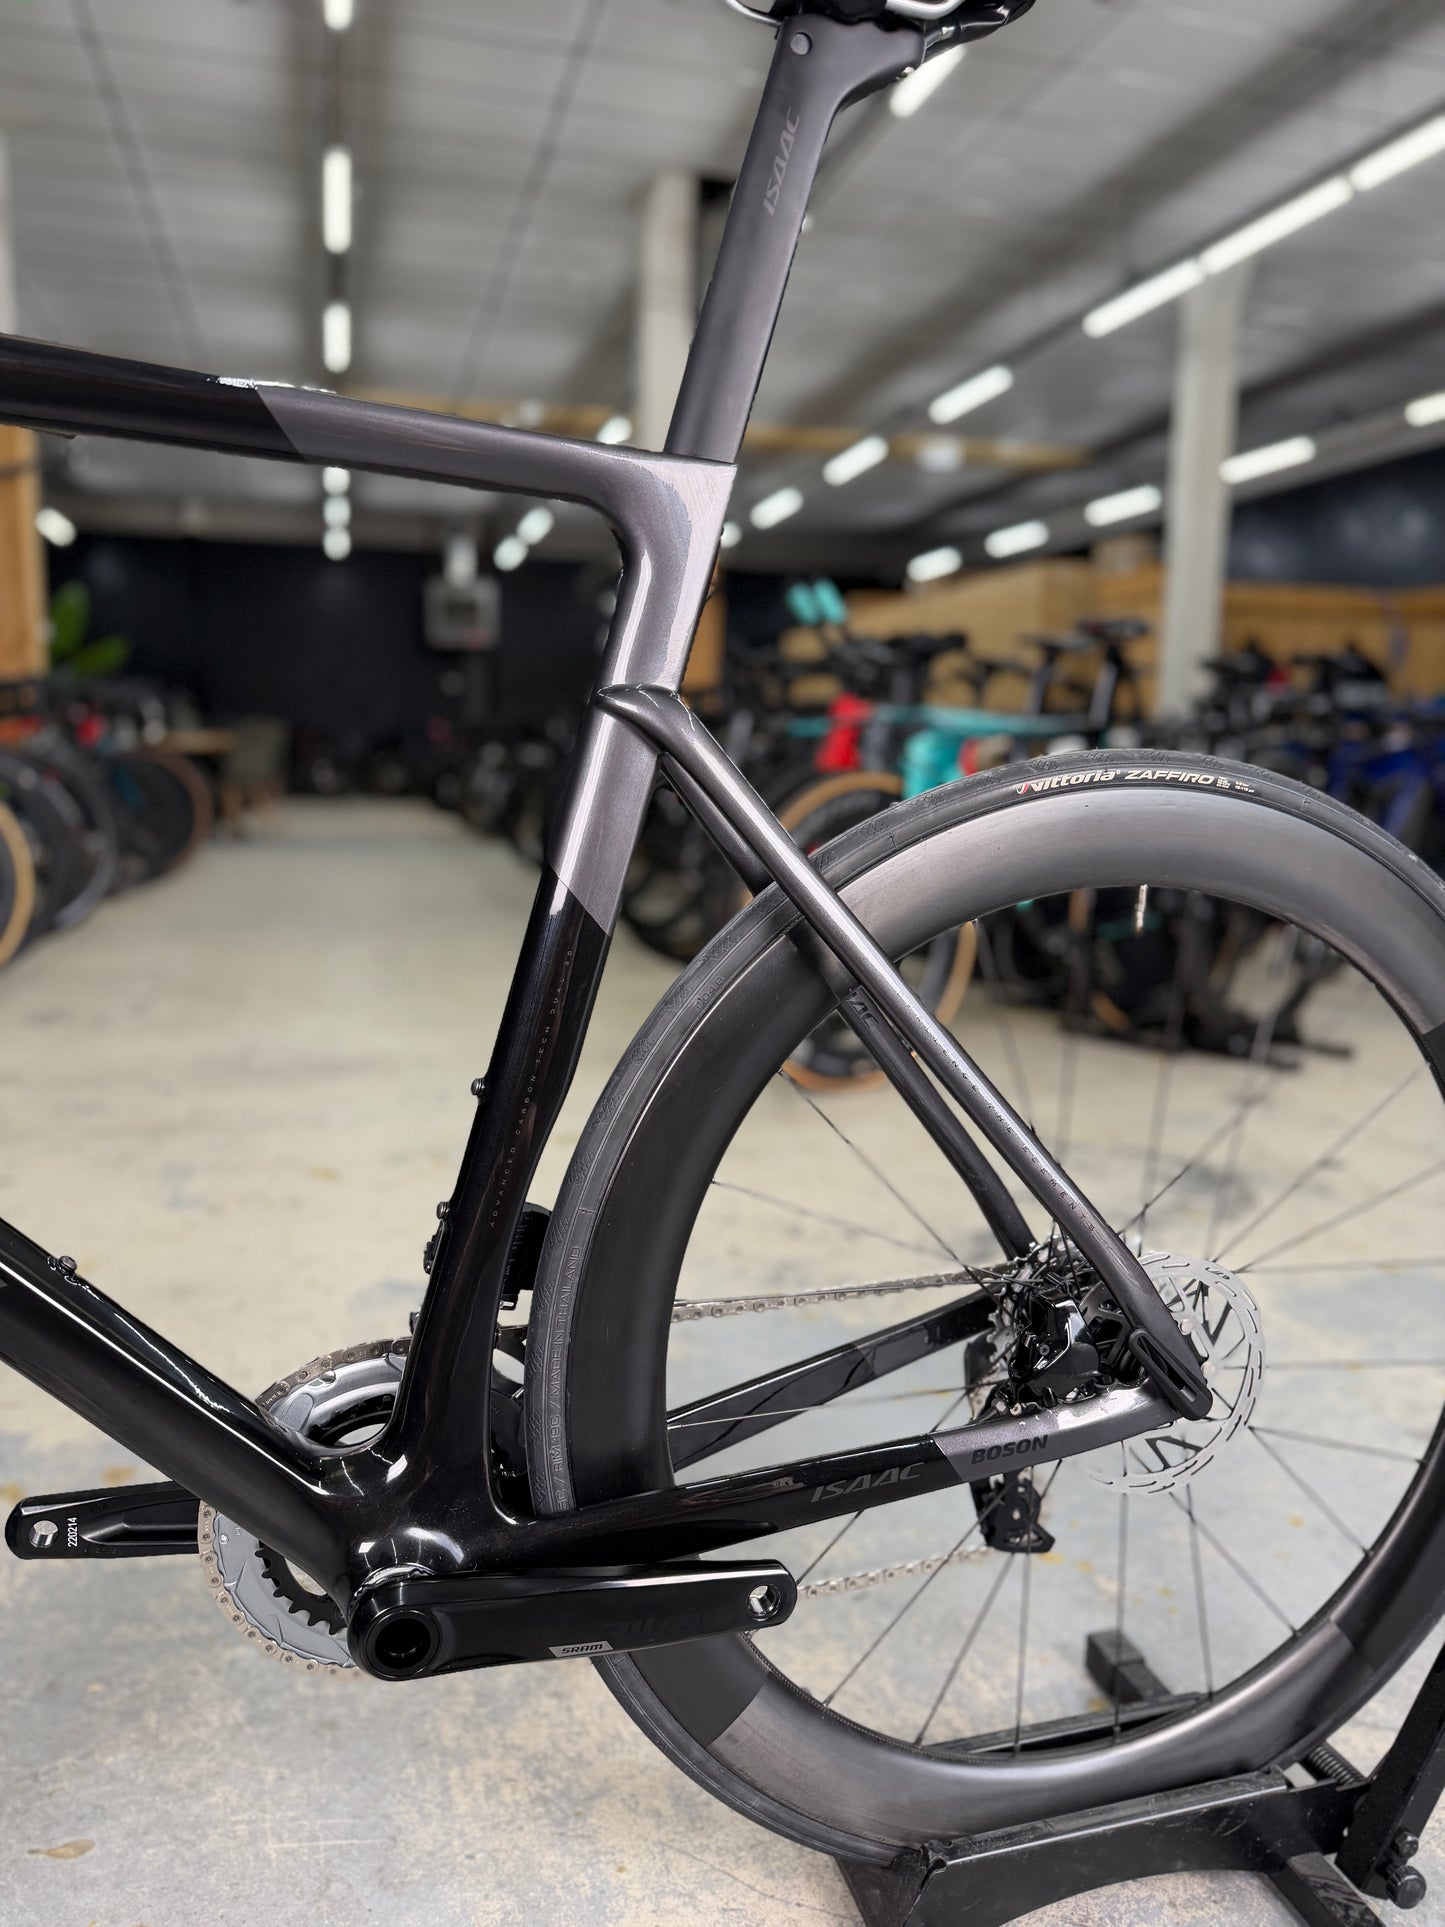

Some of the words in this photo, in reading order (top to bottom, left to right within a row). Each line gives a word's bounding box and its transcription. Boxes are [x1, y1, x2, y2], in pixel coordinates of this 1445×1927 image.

[762, 106, 800, 216] ISAAC
[1124, 769, 1214, 785] ZAFFIRO
[488, 1146, 516, 1228] ADVANCED
[536, 1026, 550, 1064] TECH
[555, 1246, 581, 1327] THAILAND
[553, 1329, 565, 1345] IN
[550, 1348, 562, 1398] MADE
[970, 1434, 1048, 1465] BOSON
[810, 1461, 925, 1503] ISAAC
[67, 1517, 78, 1547] 220214
[561, 1643, 604, 1654] SRAM
